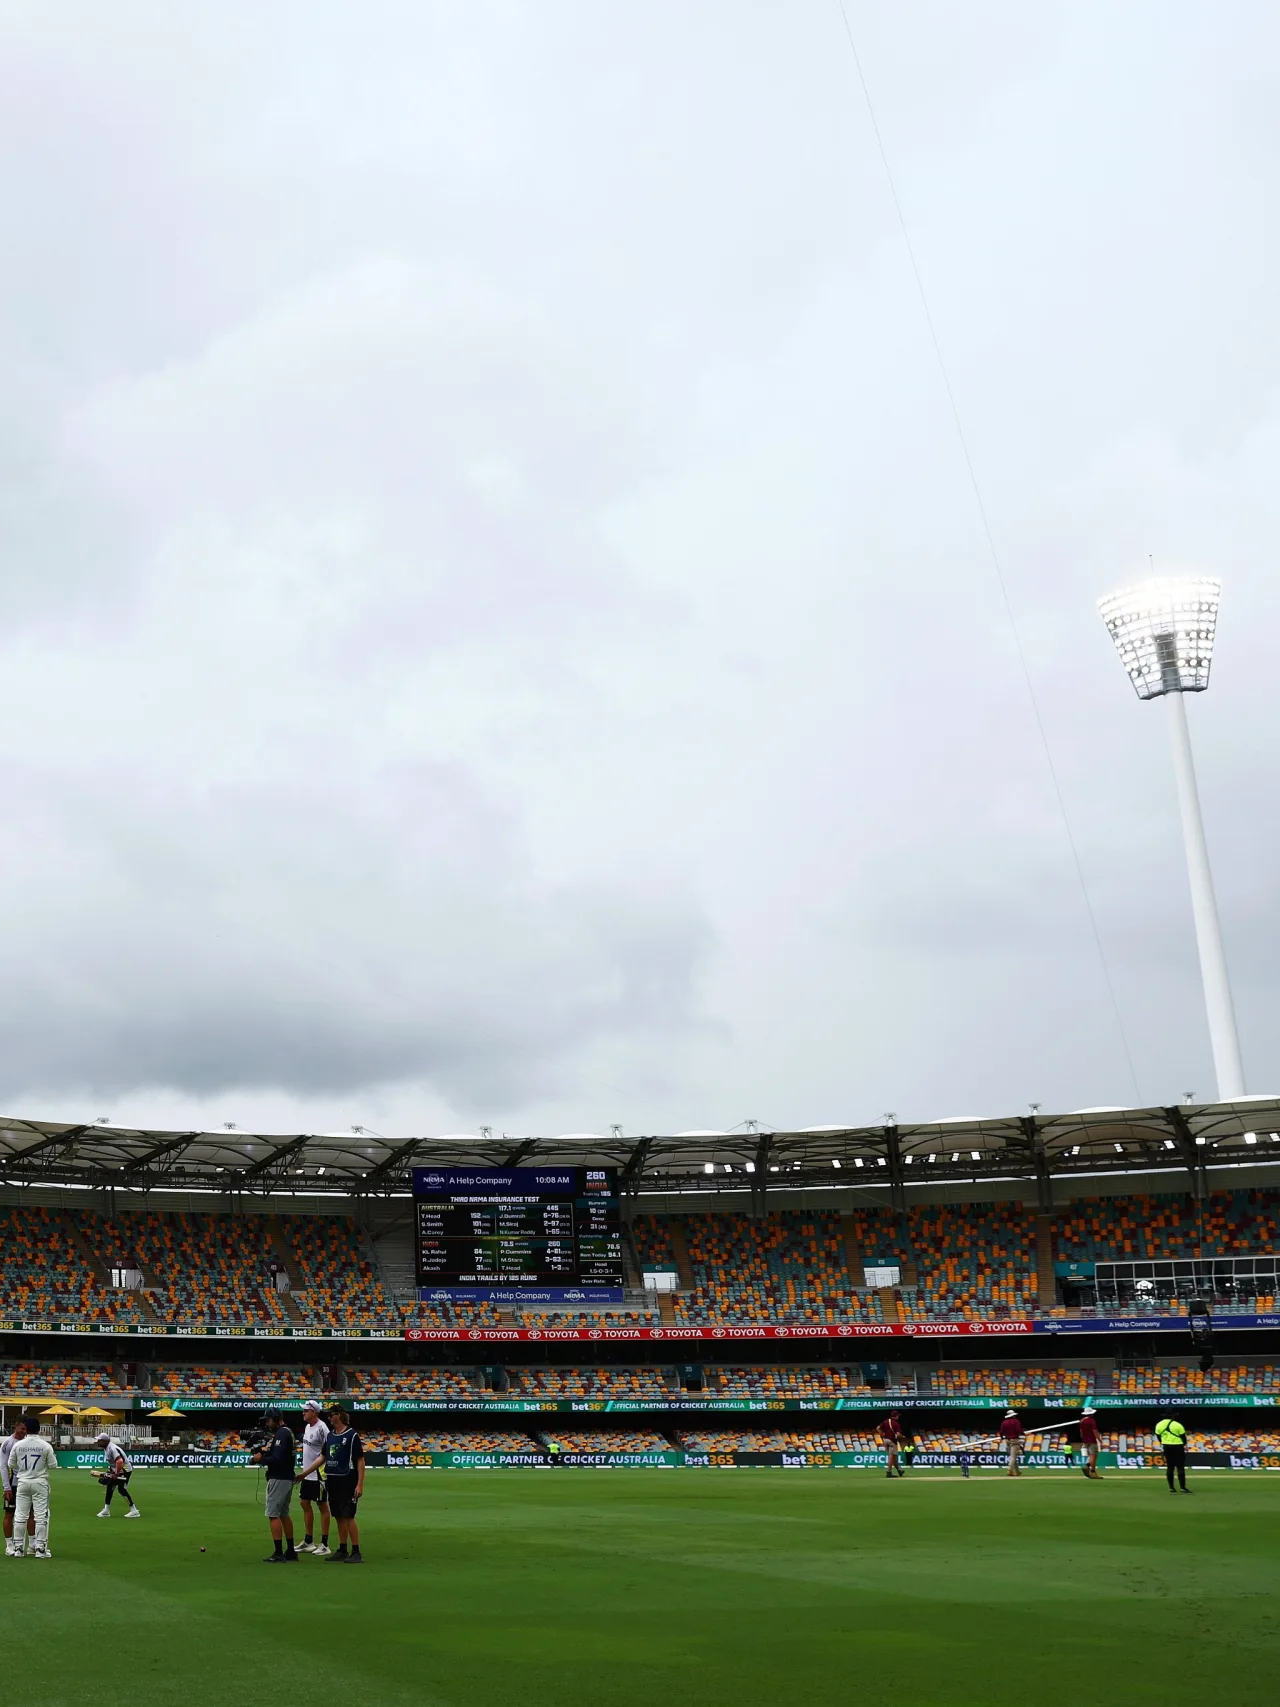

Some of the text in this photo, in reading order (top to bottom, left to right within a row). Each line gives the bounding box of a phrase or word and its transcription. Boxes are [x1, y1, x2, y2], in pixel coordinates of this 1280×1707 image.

[457, 1177, 470, 1185] Help
[471, 1177, 512, 1186] Company
[497, 1292, 513, 1300] Help
[514, 1292, 551, 1300] Company
[22, 1322, 52, 1331] bet365
[61, 1323, 91, 1332] bet365
[99, 1324, 129, 1333] bet365
[137, 1325, 167, 1334] bet365
[986, 1323, 1027, 1332] TOYOTA
[1130, 1321, 1160, 1329] Company
[176, 1326, 207, 1335] bet365
[215, 1327, 246, 1335] bet365
[254, 1328, 285, 1337] bet365
[292, 1328, 323, 1337] bet365
[331, 1329, 362, 1338] bet365
[370, 1329, 401, 1338] bet365
[424, 1331, 460, 1339] TOYOTA
[484, 1331, 519, 1339] TOYOTA
[543, 1331, 580, 1339] TOYOTA
[604, 1330, 641, 1338] TOYOTA
[666, 1329, 703, 1338] TOYOTA
[728, 1328, 766, 1337] TOYOTA
[791, 1327, 829, 1335] TOYOTA
[854, 1326, 893, 1335] TOYOTA
[243, 1400, 267, 1408] CRICKET
[524, 1402, 558, 1410] bet365
[749, 1401, 785, 1410] bet365
[872, 1400, 903, 1408] PARTNER
[989, 1398, 1028, 1407] bet365
[21, 1454, 41, 1471] 17
[167, 1455, 181, 1464] OF
[387, 1454, 432, 1465] bet365
[452, 1455, 665, 1464] OFFICIAL PARTNER CRICKET AUSTRALIA
[782, 1454, 832, 1465] bet365
